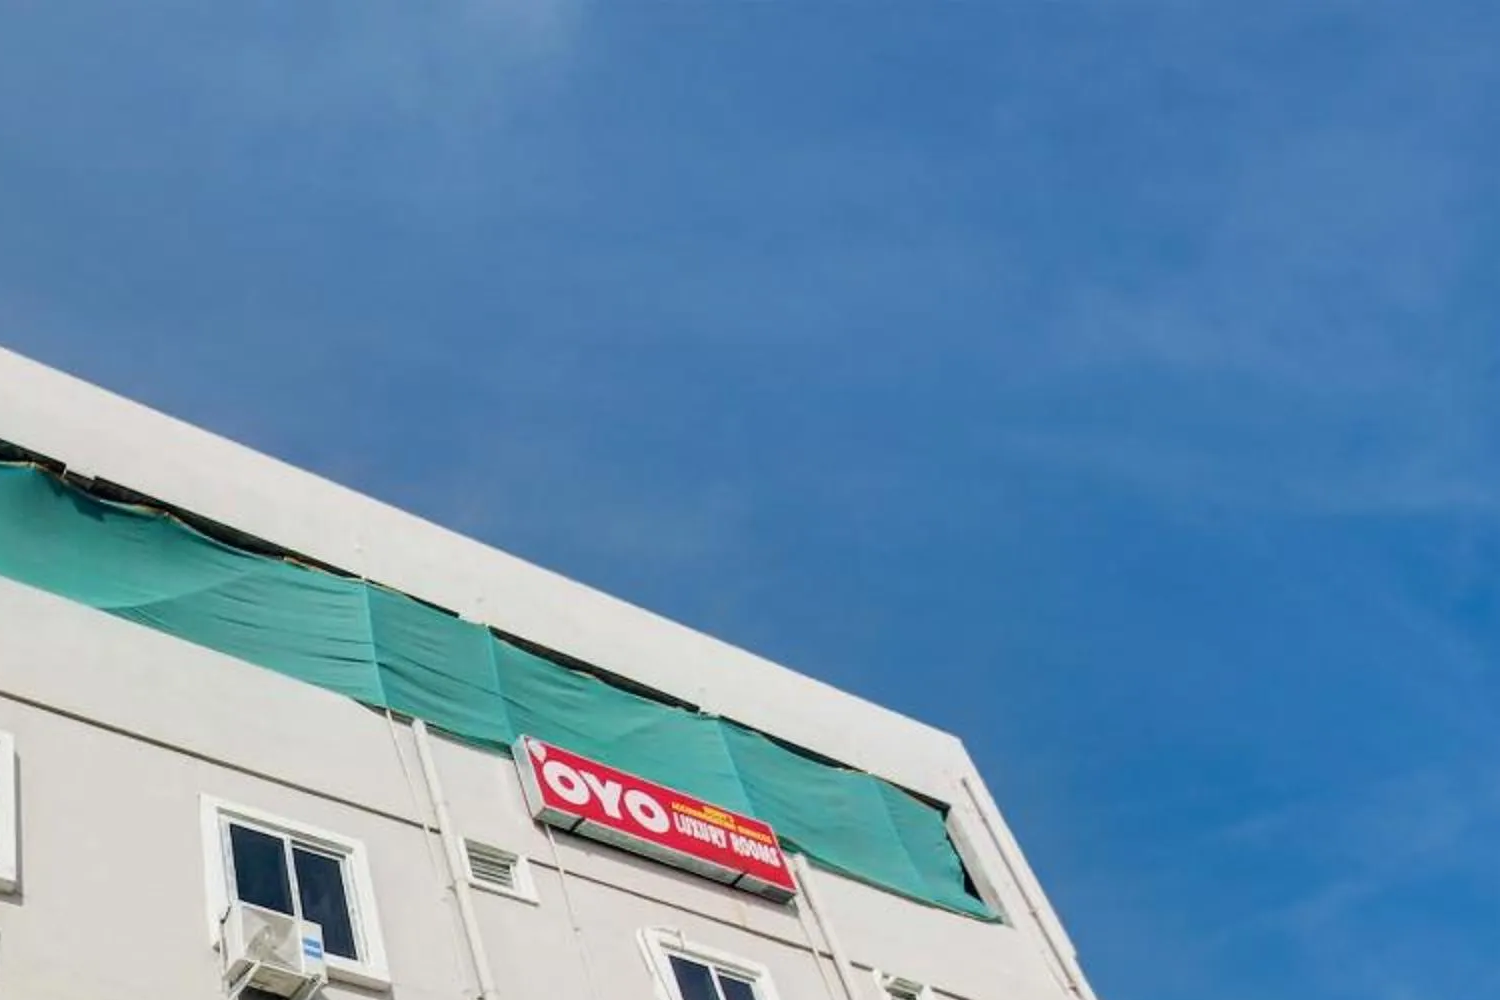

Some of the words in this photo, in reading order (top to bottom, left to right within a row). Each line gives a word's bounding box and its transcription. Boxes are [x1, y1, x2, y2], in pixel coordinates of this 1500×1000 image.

[543, 760, 670, 834] OYO
[673, 811, 727, 849] LUXURY
[729, 831, 781, 868] ROOMS
